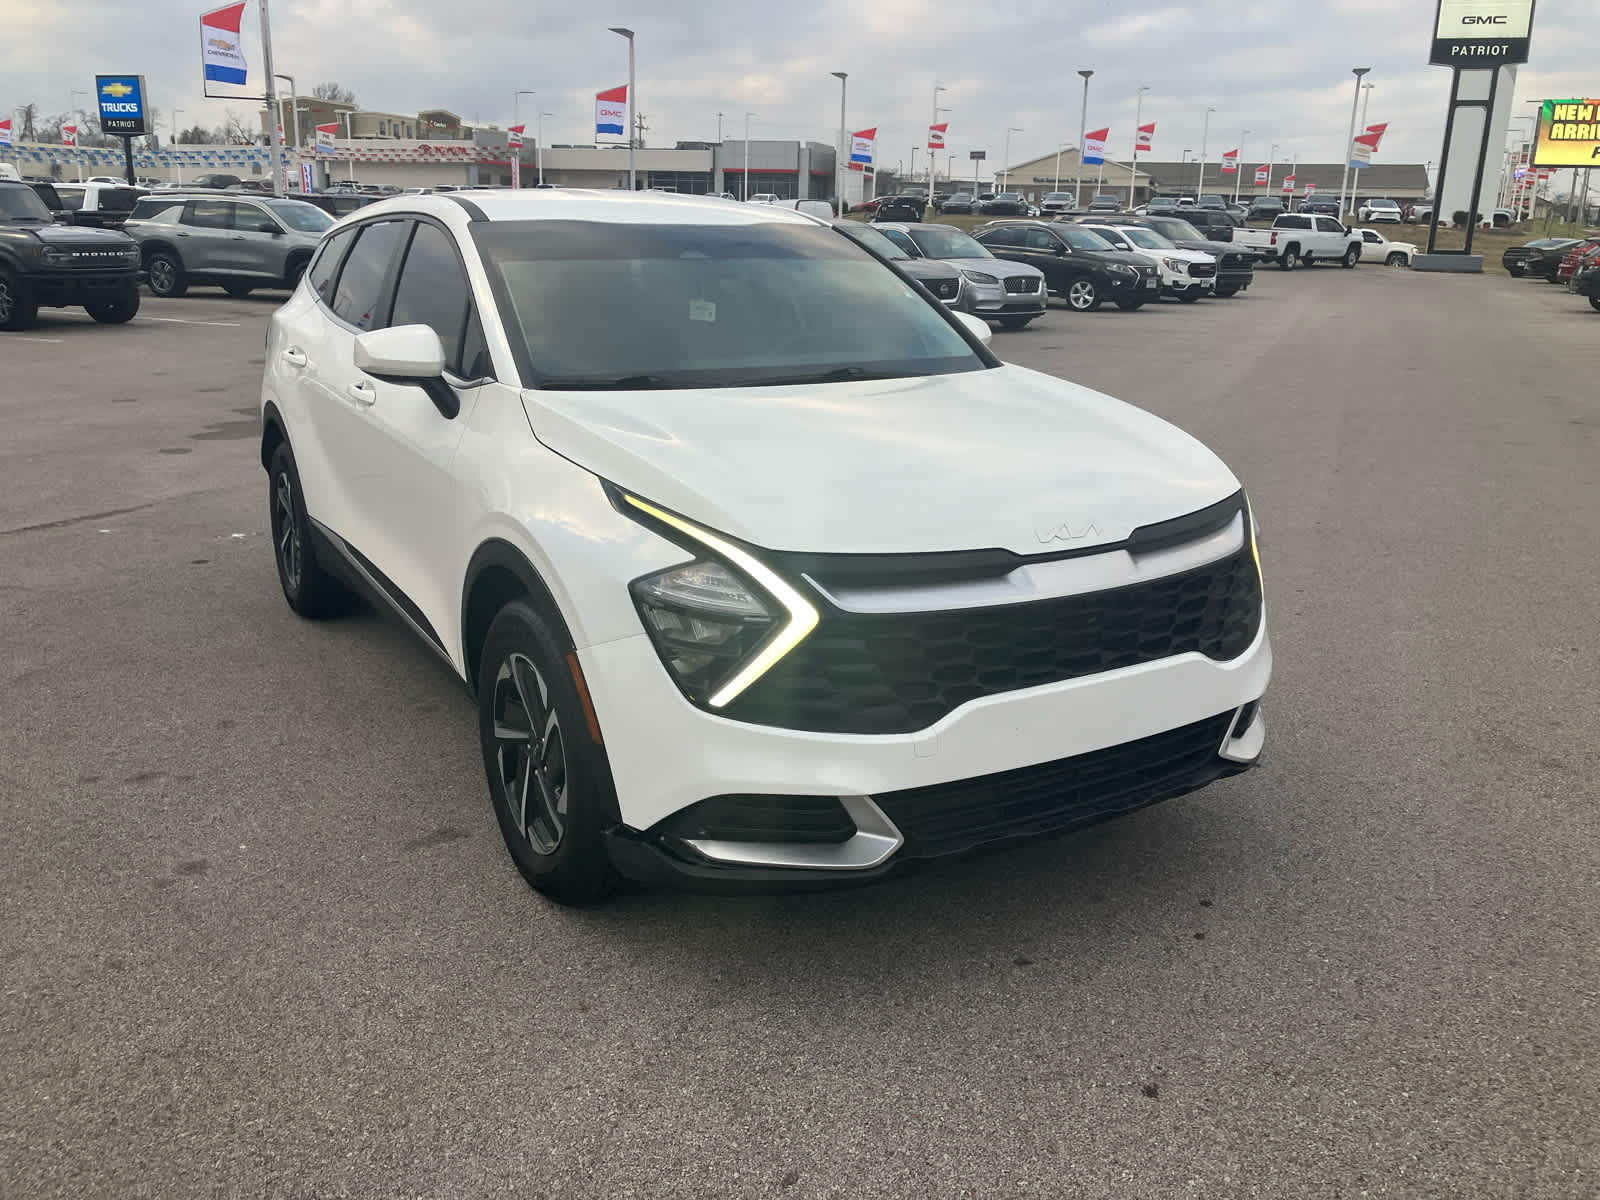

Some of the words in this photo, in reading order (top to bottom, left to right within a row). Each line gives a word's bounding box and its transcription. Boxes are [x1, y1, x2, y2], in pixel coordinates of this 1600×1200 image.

[1462, 16, 1507, 24] GMC
[1451, 45, 1508, 56] PATRIOT
[101, 102, 138, 112] TRUCKS
[600, 109, 623, 118] GMC
[1553, 104, 1594, 121] NEW
[107, 120, 136, 128] PATRIOT
[1550, 123, 1600, 140] ARRI
